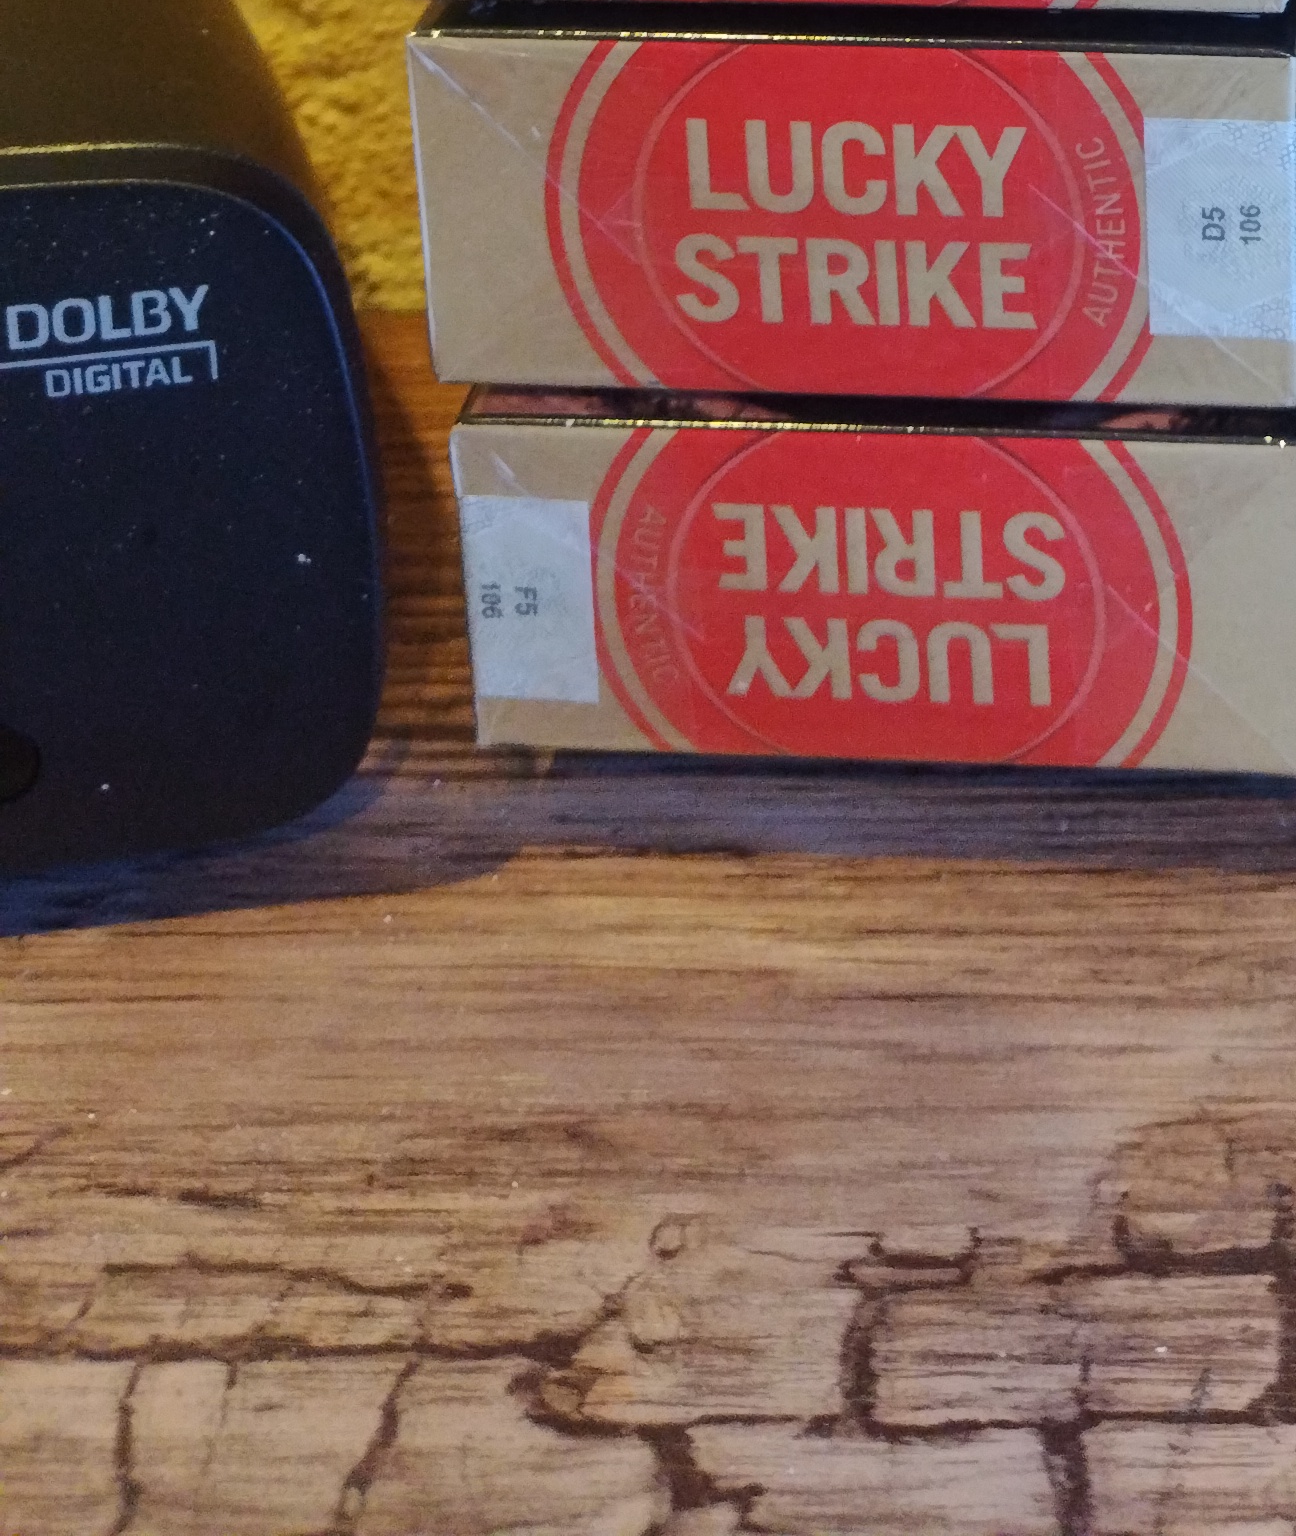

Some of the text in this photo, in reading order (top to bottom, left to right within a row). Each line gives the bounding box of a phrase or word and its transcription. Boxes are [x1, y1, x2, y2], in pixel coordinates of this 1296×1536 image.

[684, 117, 1027, 219] LUCKY
[1075, 136, 1126, 328] AUTHENTIC
[1201, 206, 1226, 242] D5
[1239, 204, 1261, 245] 106
[674, 234, 1038, 332] STRIKE
[6, 284, 209, 350] DOLBY
[45, 357, 193, 397] DIGITAL
[711, 502, 1068, 602] STRIKE
[481, 581, 503, 619] 106
[514, 585, 538, 617] F5
[727, 614, 1052, 707] LUCKY
